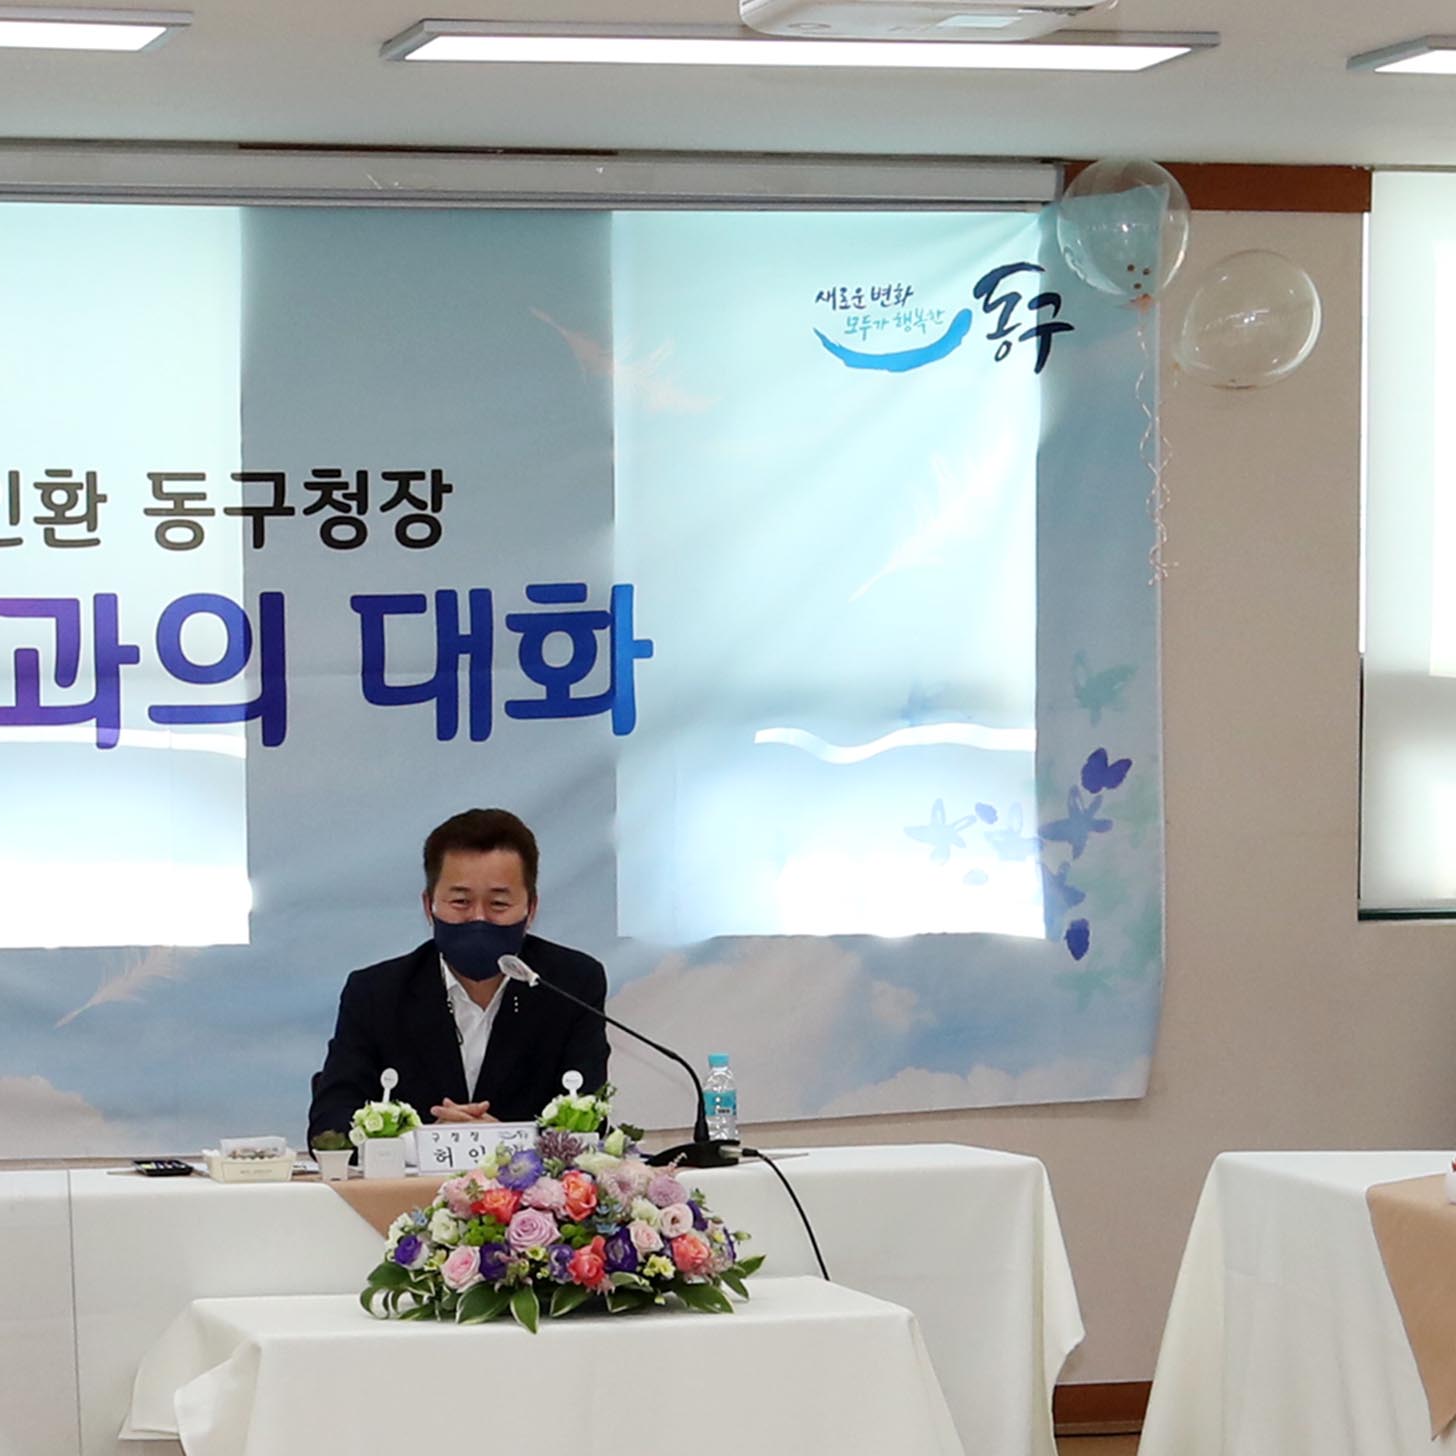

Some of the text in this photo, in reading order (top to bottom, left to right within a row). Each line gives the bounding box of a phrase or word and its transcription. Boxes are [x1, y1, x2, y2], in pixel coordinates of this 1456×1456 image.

[815, 282, 915, 311] 새로운 변화
[844, 307, 945, 342] 모두가 행복한
[972, 261, 1076, 375] 동구
[141, 466, 454, 551] 동구청장
[349, 582, 655, 744] 대화
